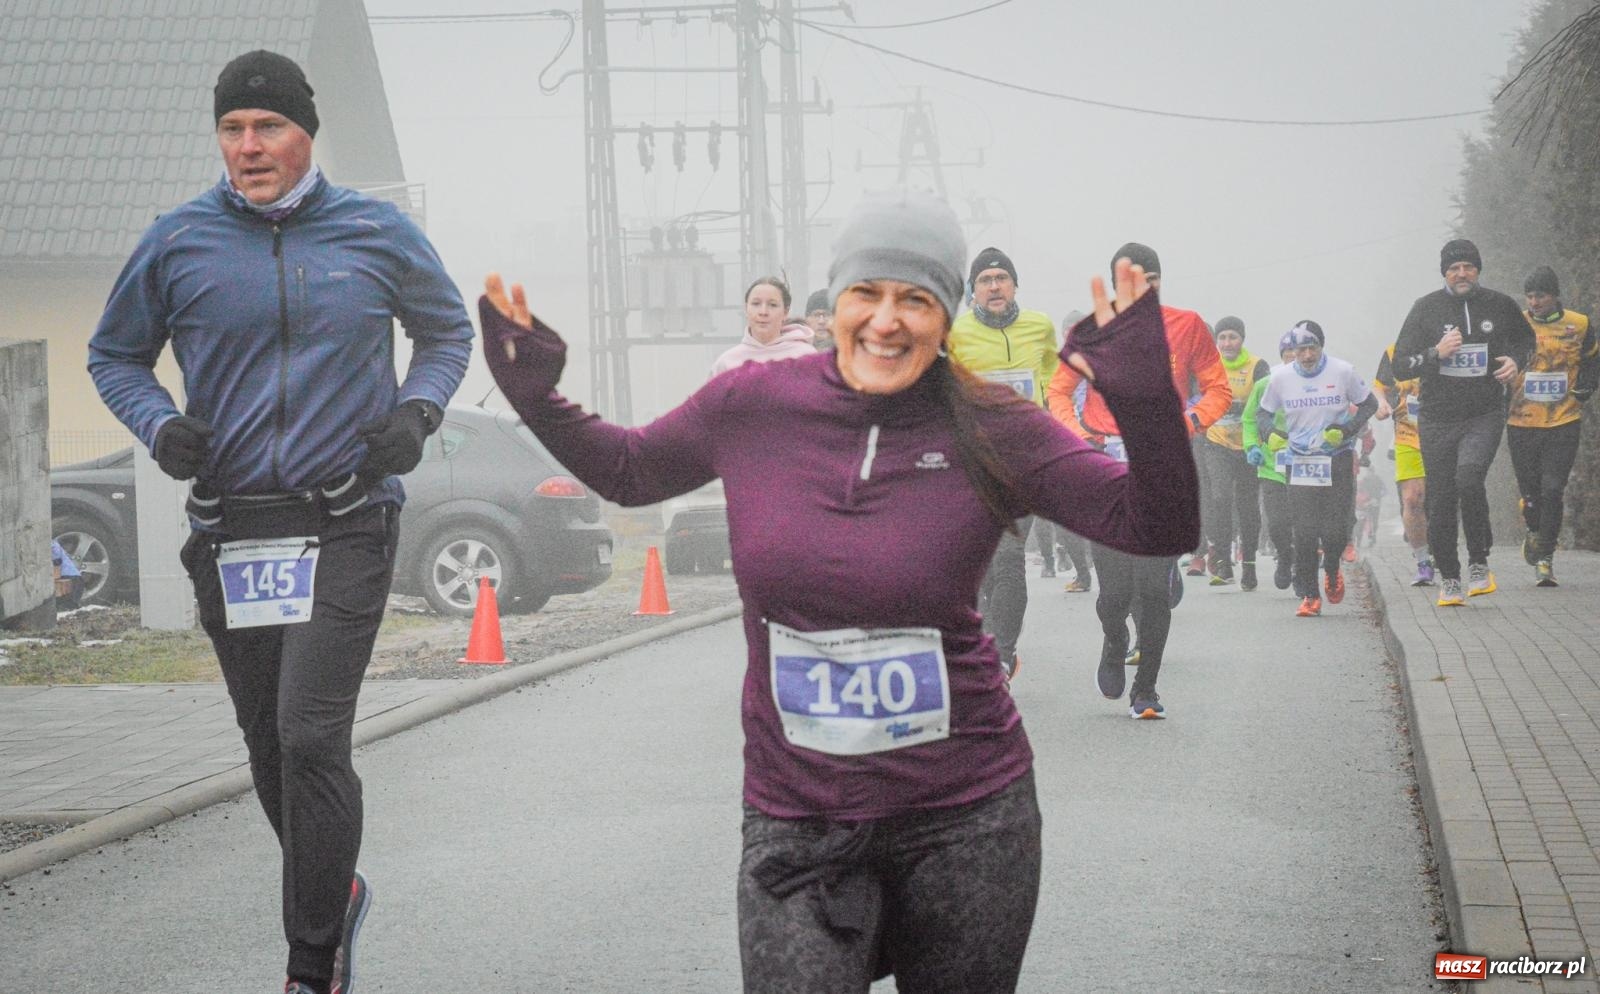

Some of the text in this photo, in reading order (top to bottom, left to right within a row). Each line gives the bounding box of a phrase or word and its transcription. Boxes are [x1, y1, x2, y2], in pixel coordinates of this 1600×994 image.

[1450, 353, 1479, 367] 131
[1532, 381, 1560, 393] 113
[1286, 395, 1341, 409] RUNNERS
[1300, 464, 1325, 477] 194
[241, 561, 296, 599] 145
[806, 660, 916, 715] 140
